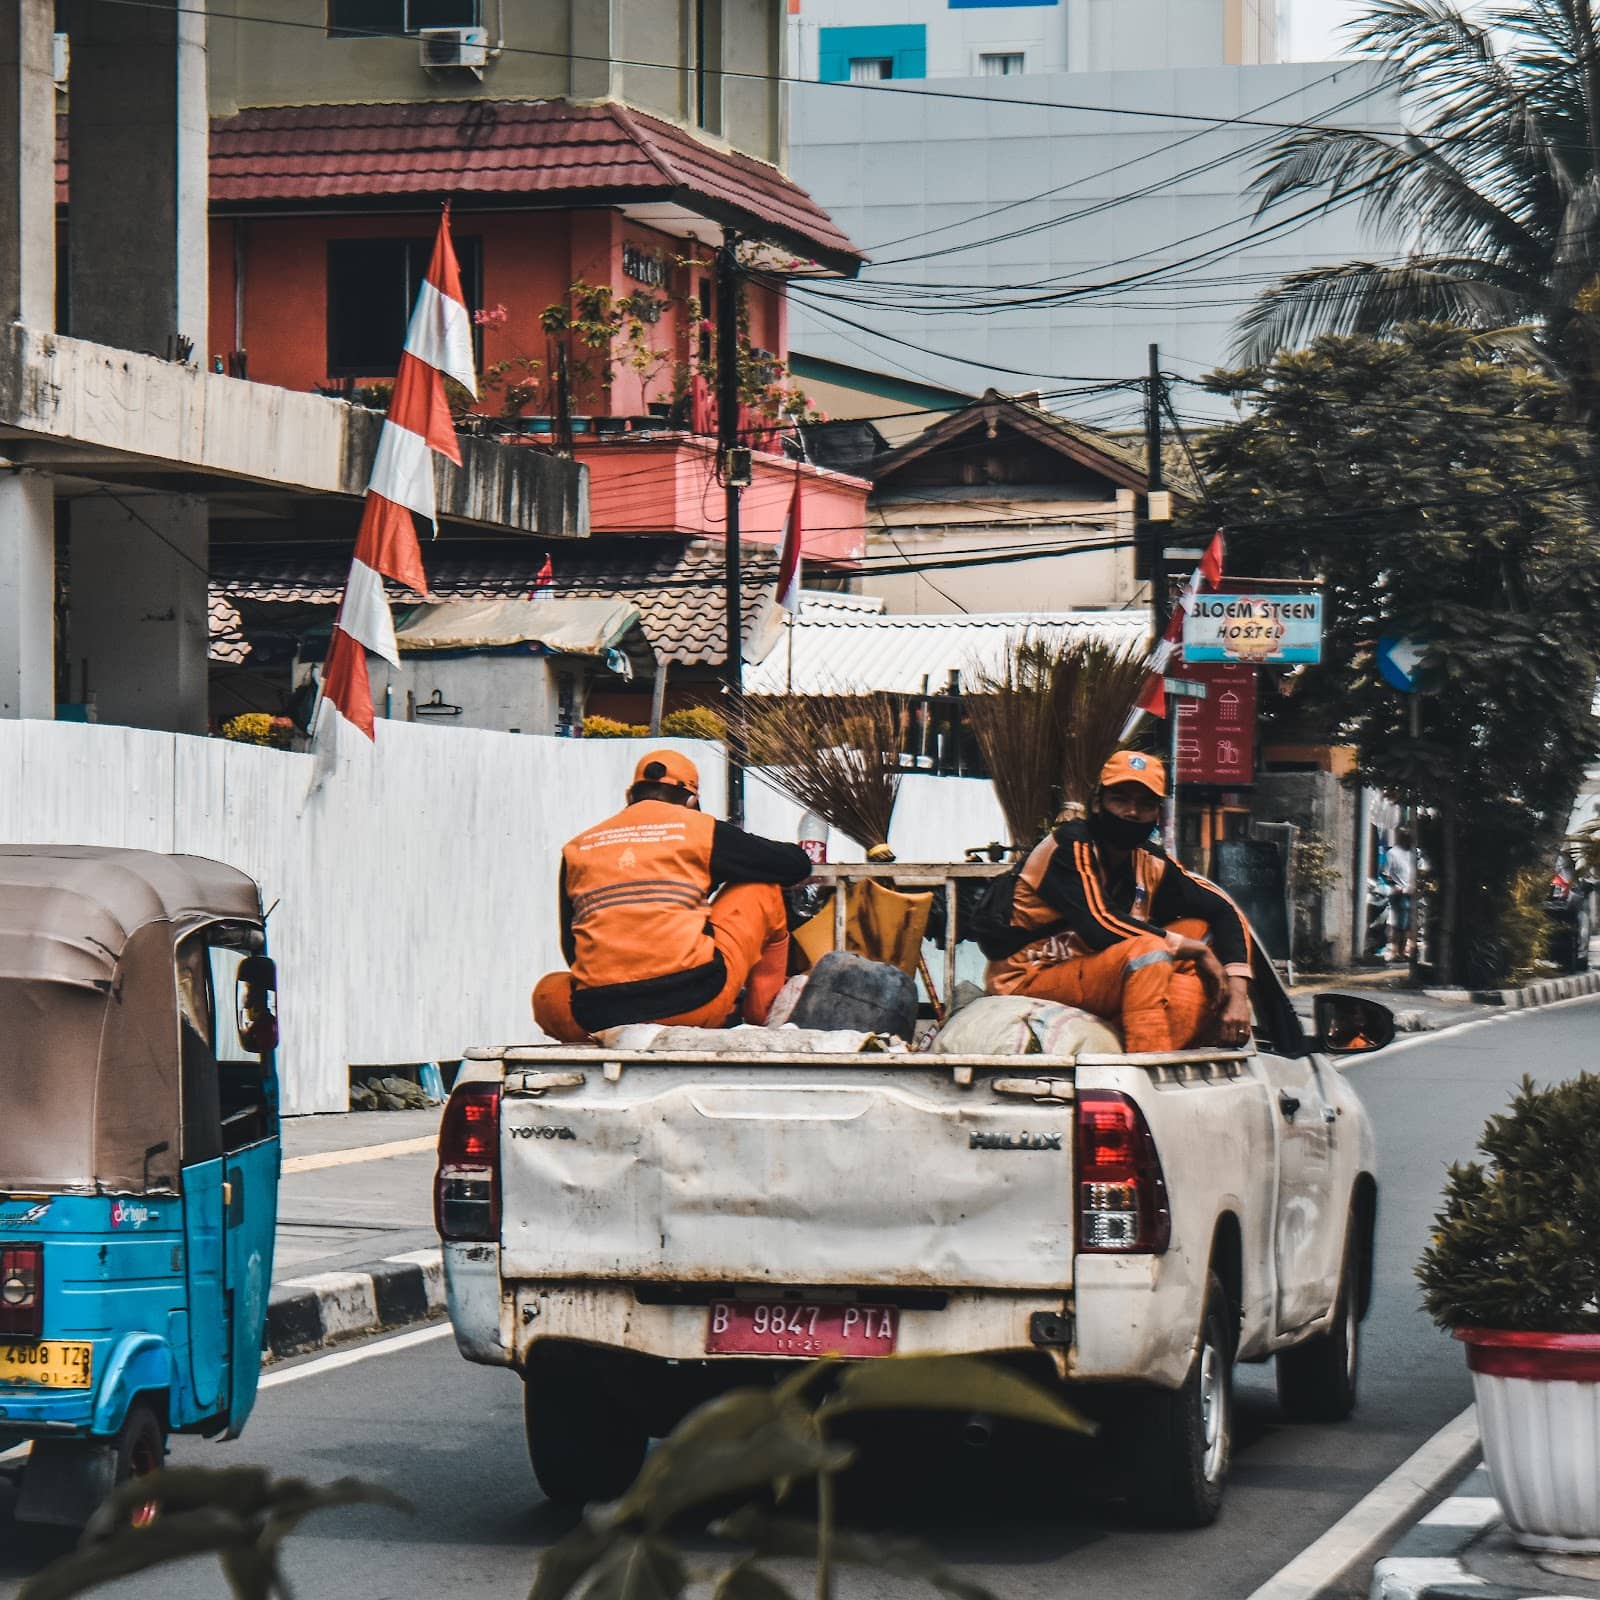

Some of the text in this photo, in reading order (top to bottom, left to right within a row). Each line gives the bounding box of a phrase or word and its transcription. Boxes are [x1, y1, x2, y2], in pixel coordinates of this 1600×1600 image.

[1191, 602, 1315, 619] BLOEM STEEN
[1216, 626, 1281, 639] HOSTEL
[509, 1127, 577, 1140] TOYOTA
[713, 1304, 893, 1339] B 9847 PTA
[776, 1338, 822, 1351] 11-25
